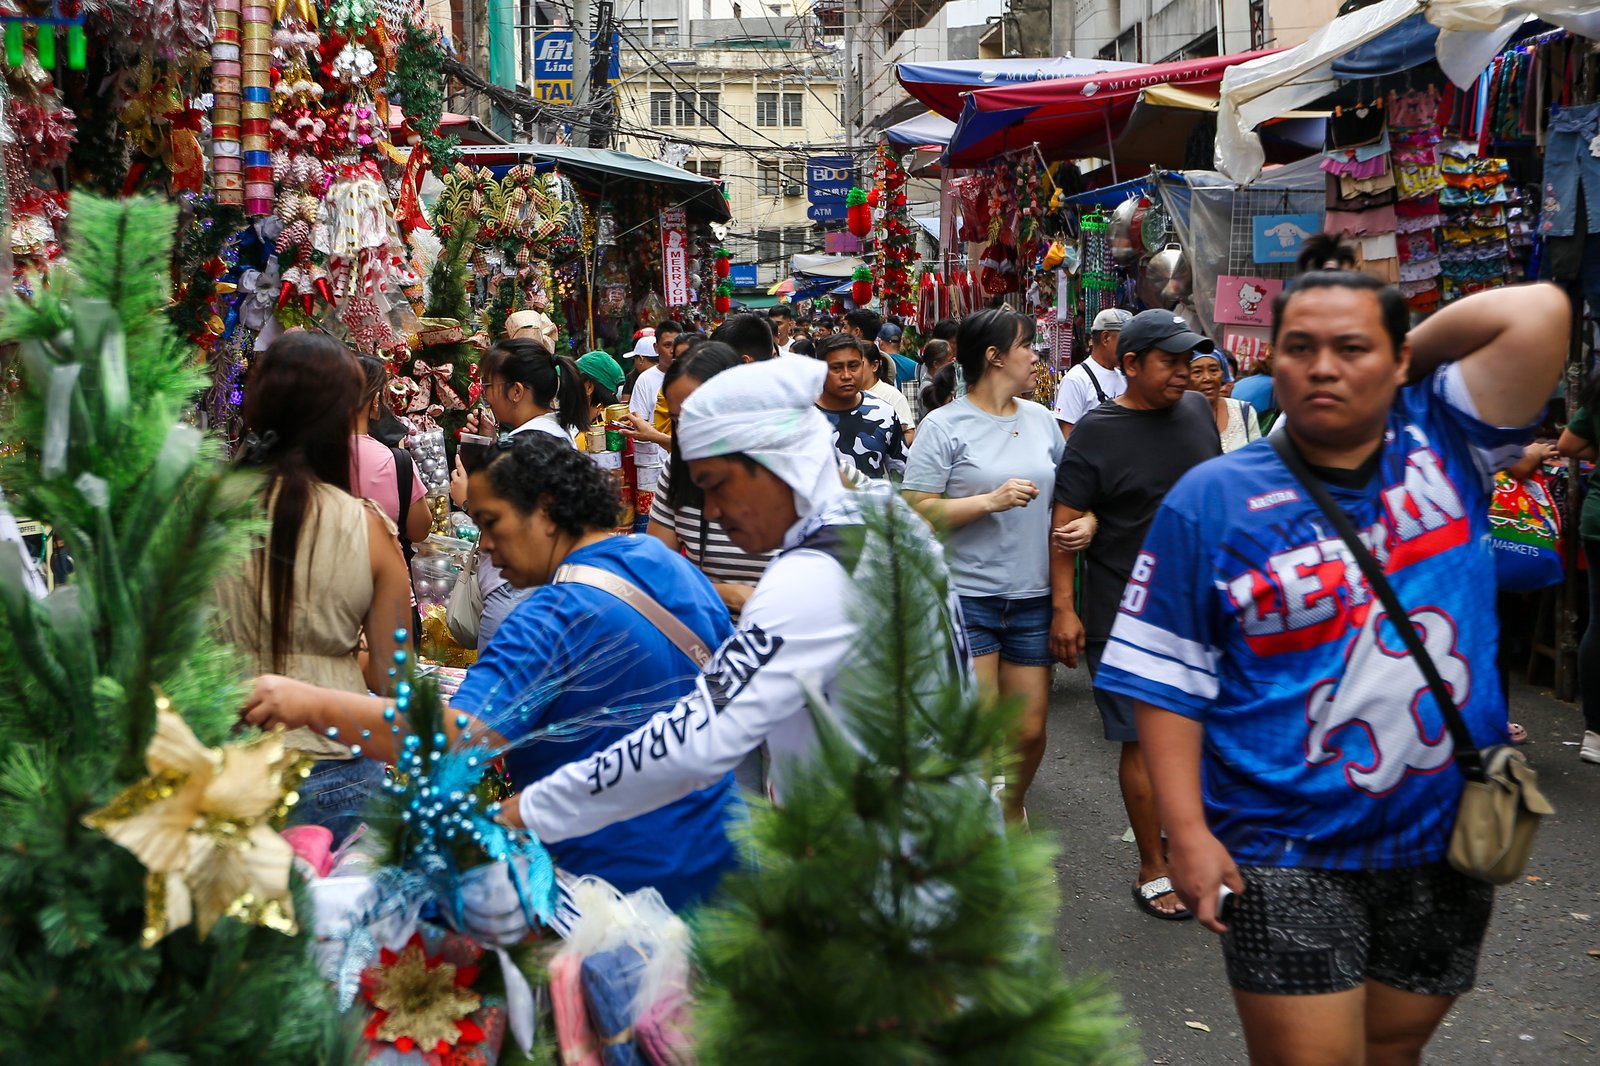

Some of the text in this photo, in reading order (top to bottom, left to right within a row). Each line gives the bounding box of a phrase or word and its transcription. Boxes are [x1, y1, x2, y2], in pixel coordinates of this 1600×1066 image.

[1005, 71, 1082, 81] MICROM
[1109, 67, 1210, 91] MICROMATIC
[813, 168, 848, 181] BDO
[814, 208, 832, 216] ATM
[1492, 539, 1540, 557] MARKETS
